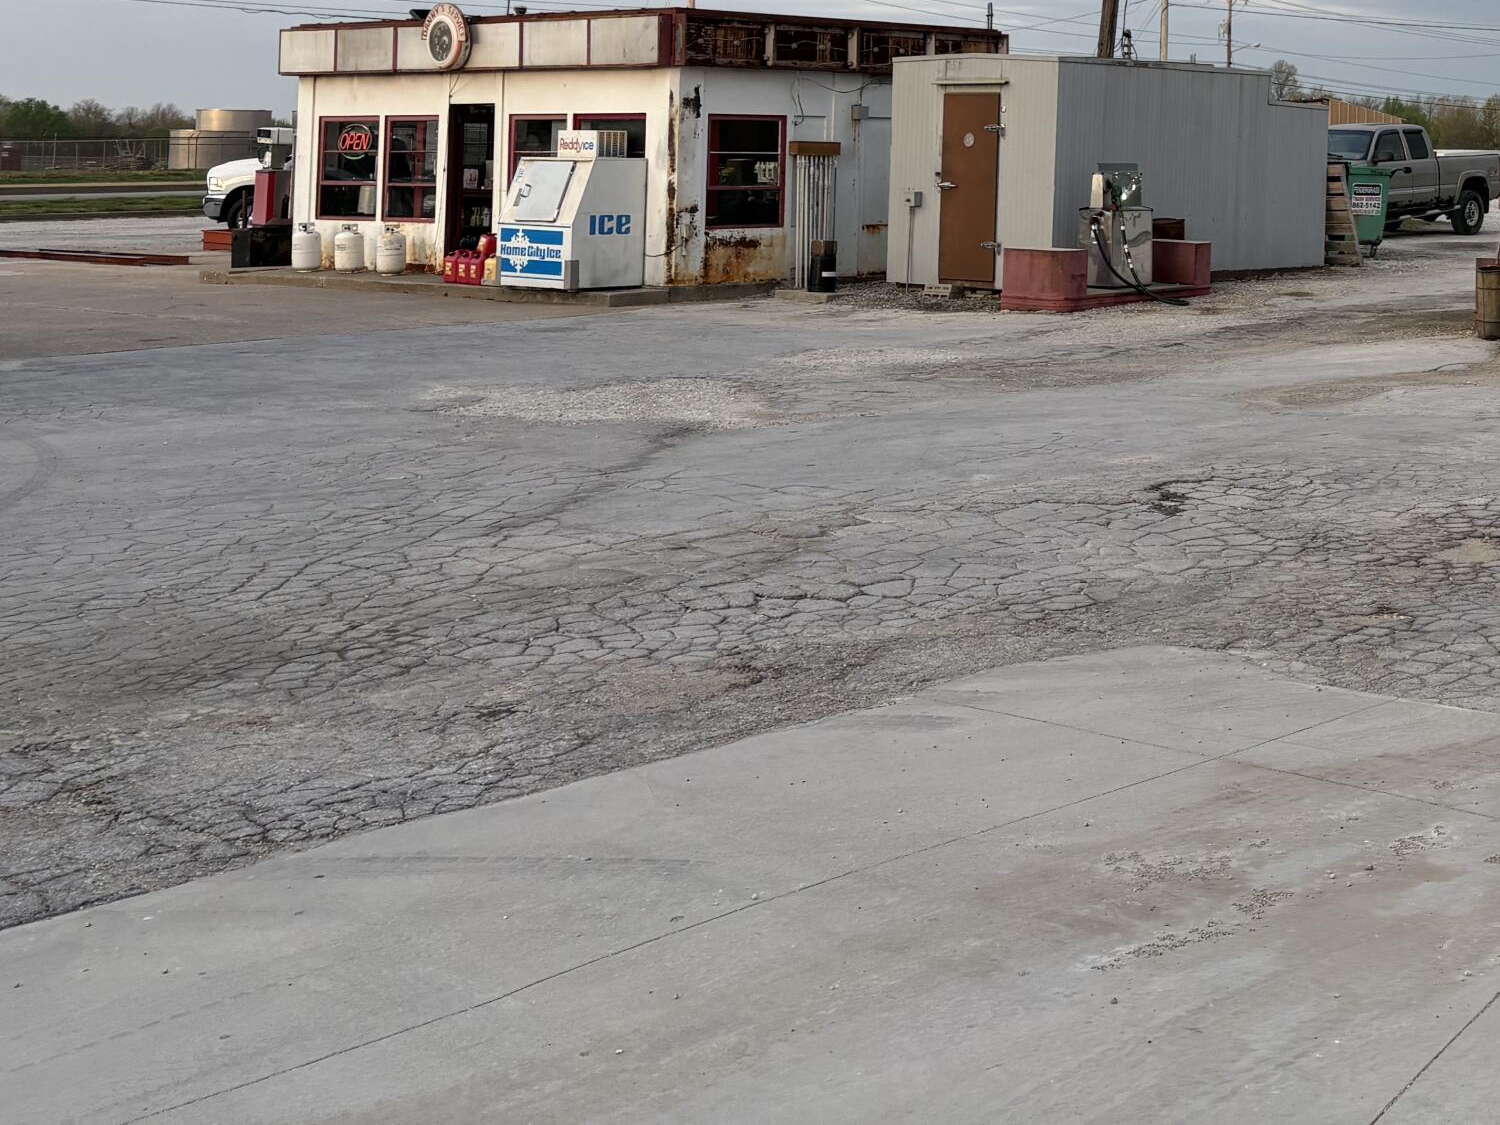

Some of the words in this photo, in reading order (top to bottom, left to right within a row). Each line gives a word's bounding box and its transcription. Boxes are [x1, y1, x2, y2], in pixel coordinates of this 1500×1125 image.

[340, 133, 370, 150] OPEN
[500, 244, 526, 256] Home
[527, 245, 546, 259] City
[546, 247, 561, 258] Ice
